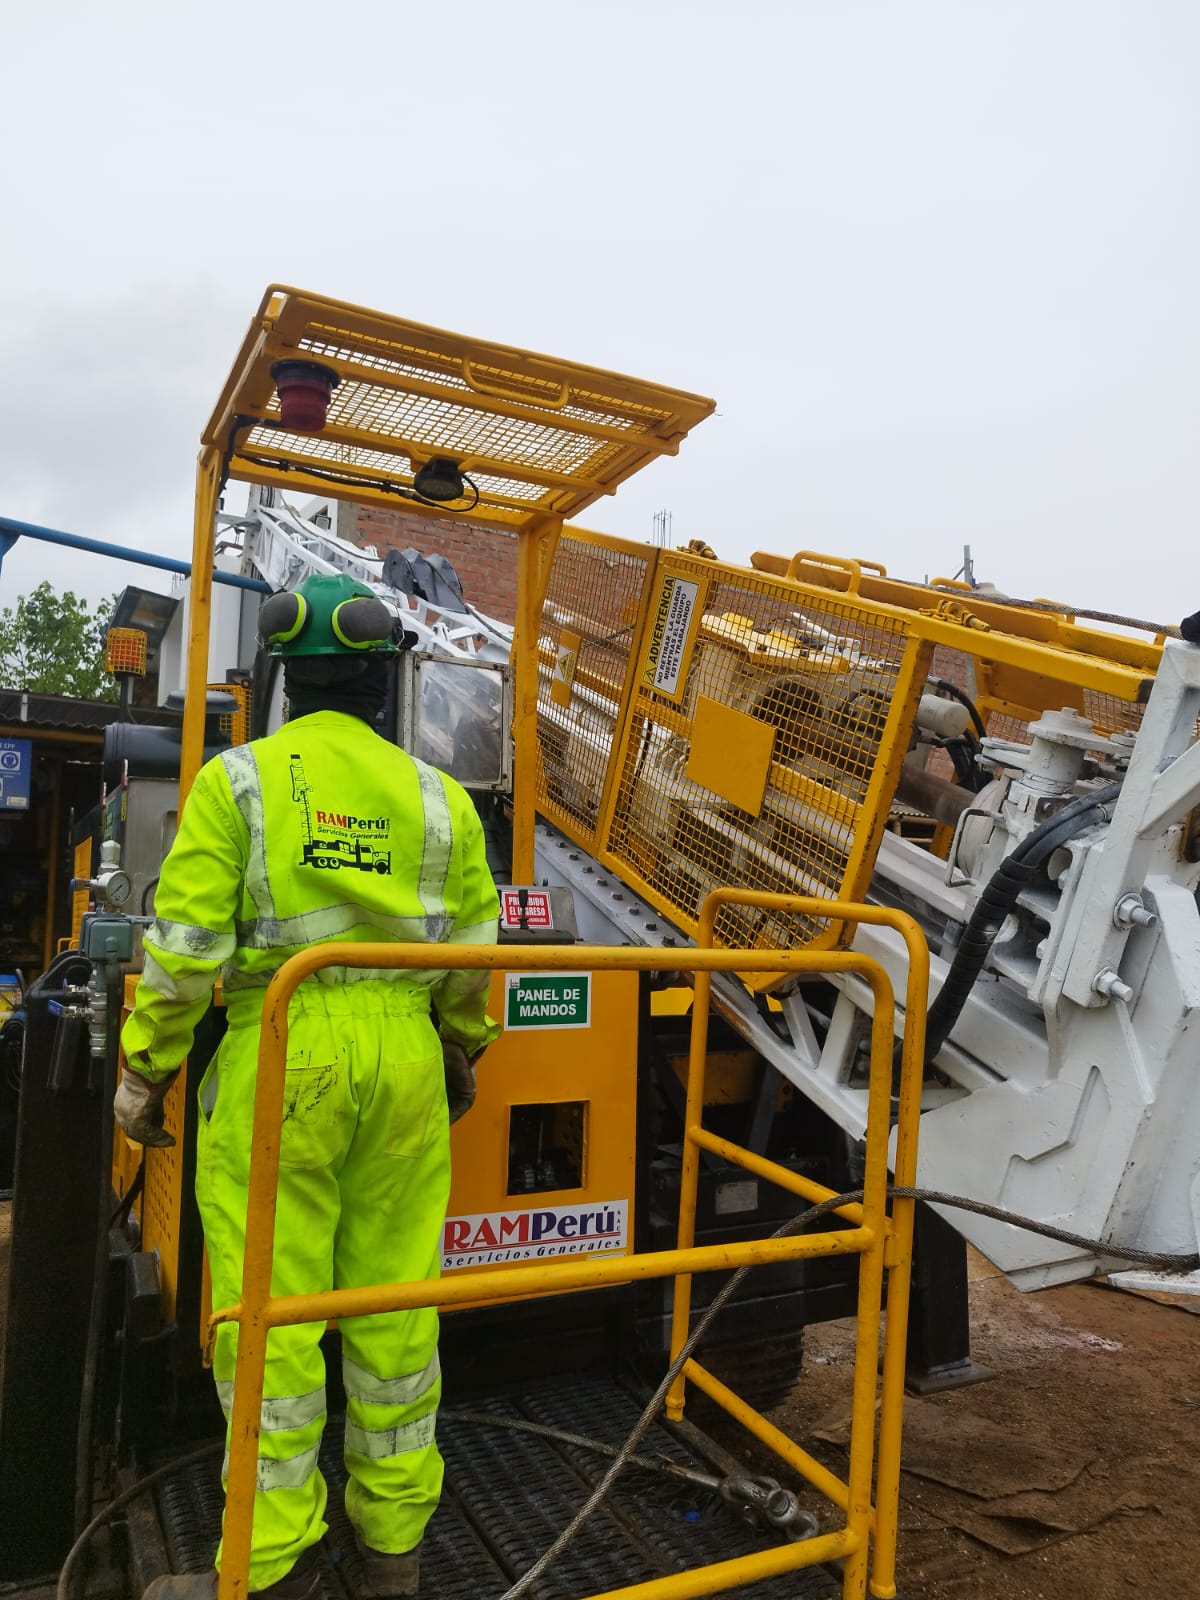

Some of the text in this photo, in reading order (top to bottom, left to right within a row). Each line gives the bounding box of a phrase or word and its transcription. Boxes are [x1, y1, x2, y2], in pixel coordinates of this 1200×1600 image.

[649, 579, 675, 664] ADVERTENCIA
[657, 586, 682, 684] NO RETIRAR LA GUARDA
[664, 593, 687, 680] MIENTRAS EL EQUIPO
[670, 600, 692, 678] ESTE TRABAJANDO
[317, 826, 348, 838] Servicios
[509, 906, 517, 915] EL
[516, 988, 581, 1002] PANEL DE
[519, 1003, 577, 1017] MANDOS
[443, 1239, 621, 1267] Servicios Generales
